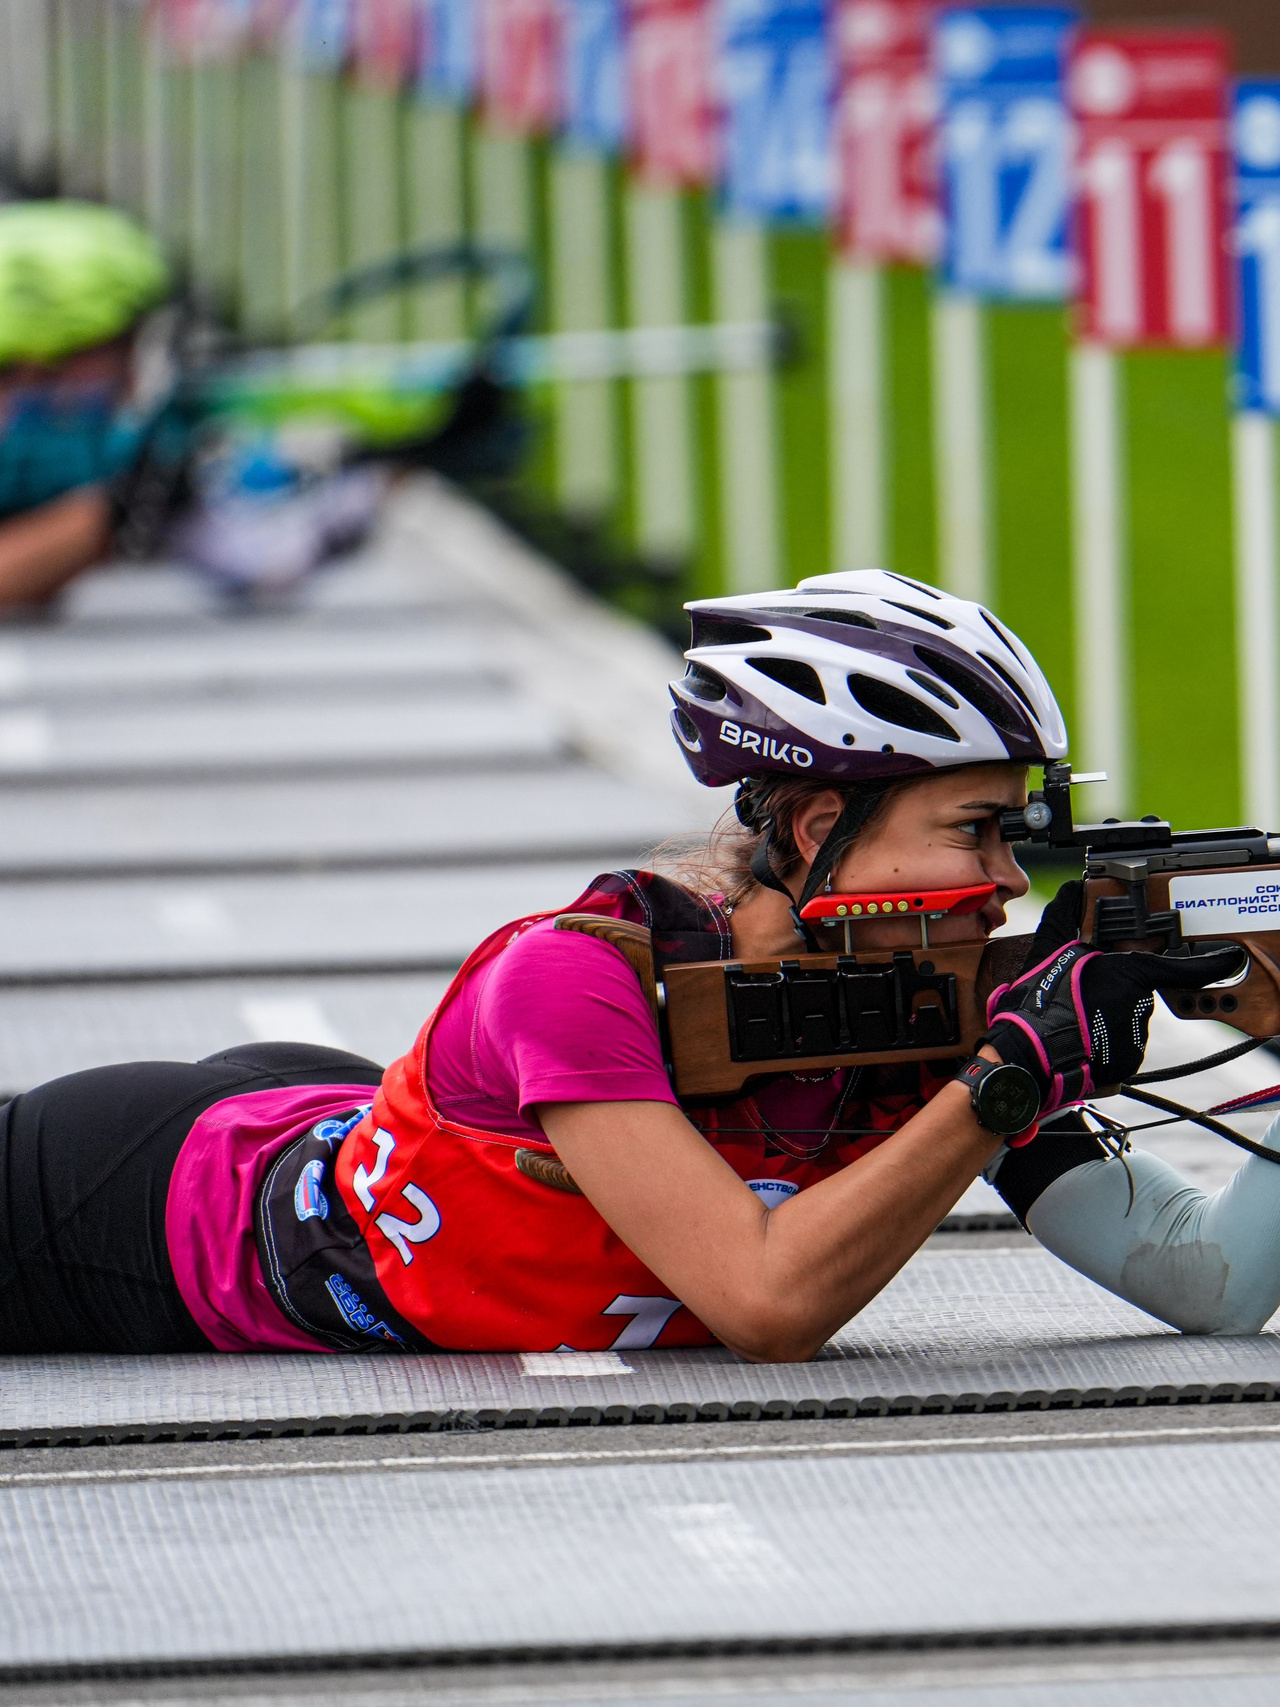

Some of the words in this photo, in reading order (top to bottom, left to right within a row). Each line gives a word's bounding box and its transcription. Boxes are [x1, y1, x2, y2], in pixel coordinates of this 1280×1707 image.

[947, 98, 1080, 296] 12
[1080, 137, 1214, 345] 11
[719, 720, 813, 767] BRIKO
[1040, 949, 1076, 991] EasySki
[748, 1182, 797, 1196] ЕНСТВО
